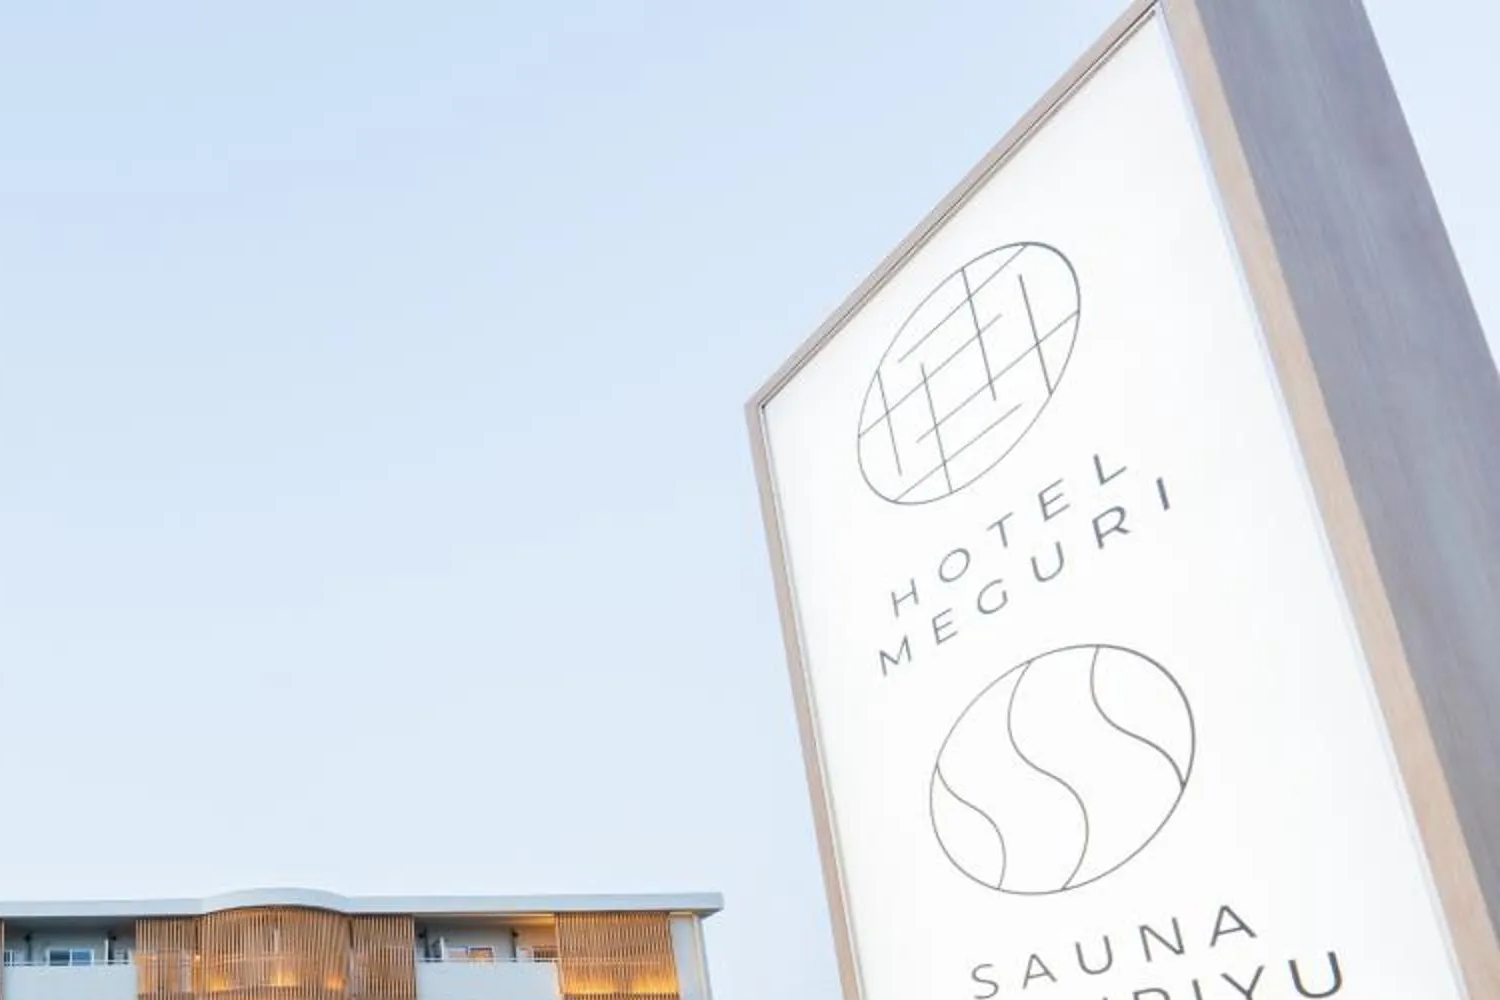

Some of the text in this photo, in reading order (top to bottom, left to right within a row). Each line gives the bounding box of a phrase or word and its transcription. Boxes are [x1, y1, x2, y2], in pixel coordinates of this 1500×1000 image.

[878, 476, 1171, 677] MEGURI
[890, 453, 1128, 618] HOTEL
[970, 904, 1258, 1000] SAUNA
